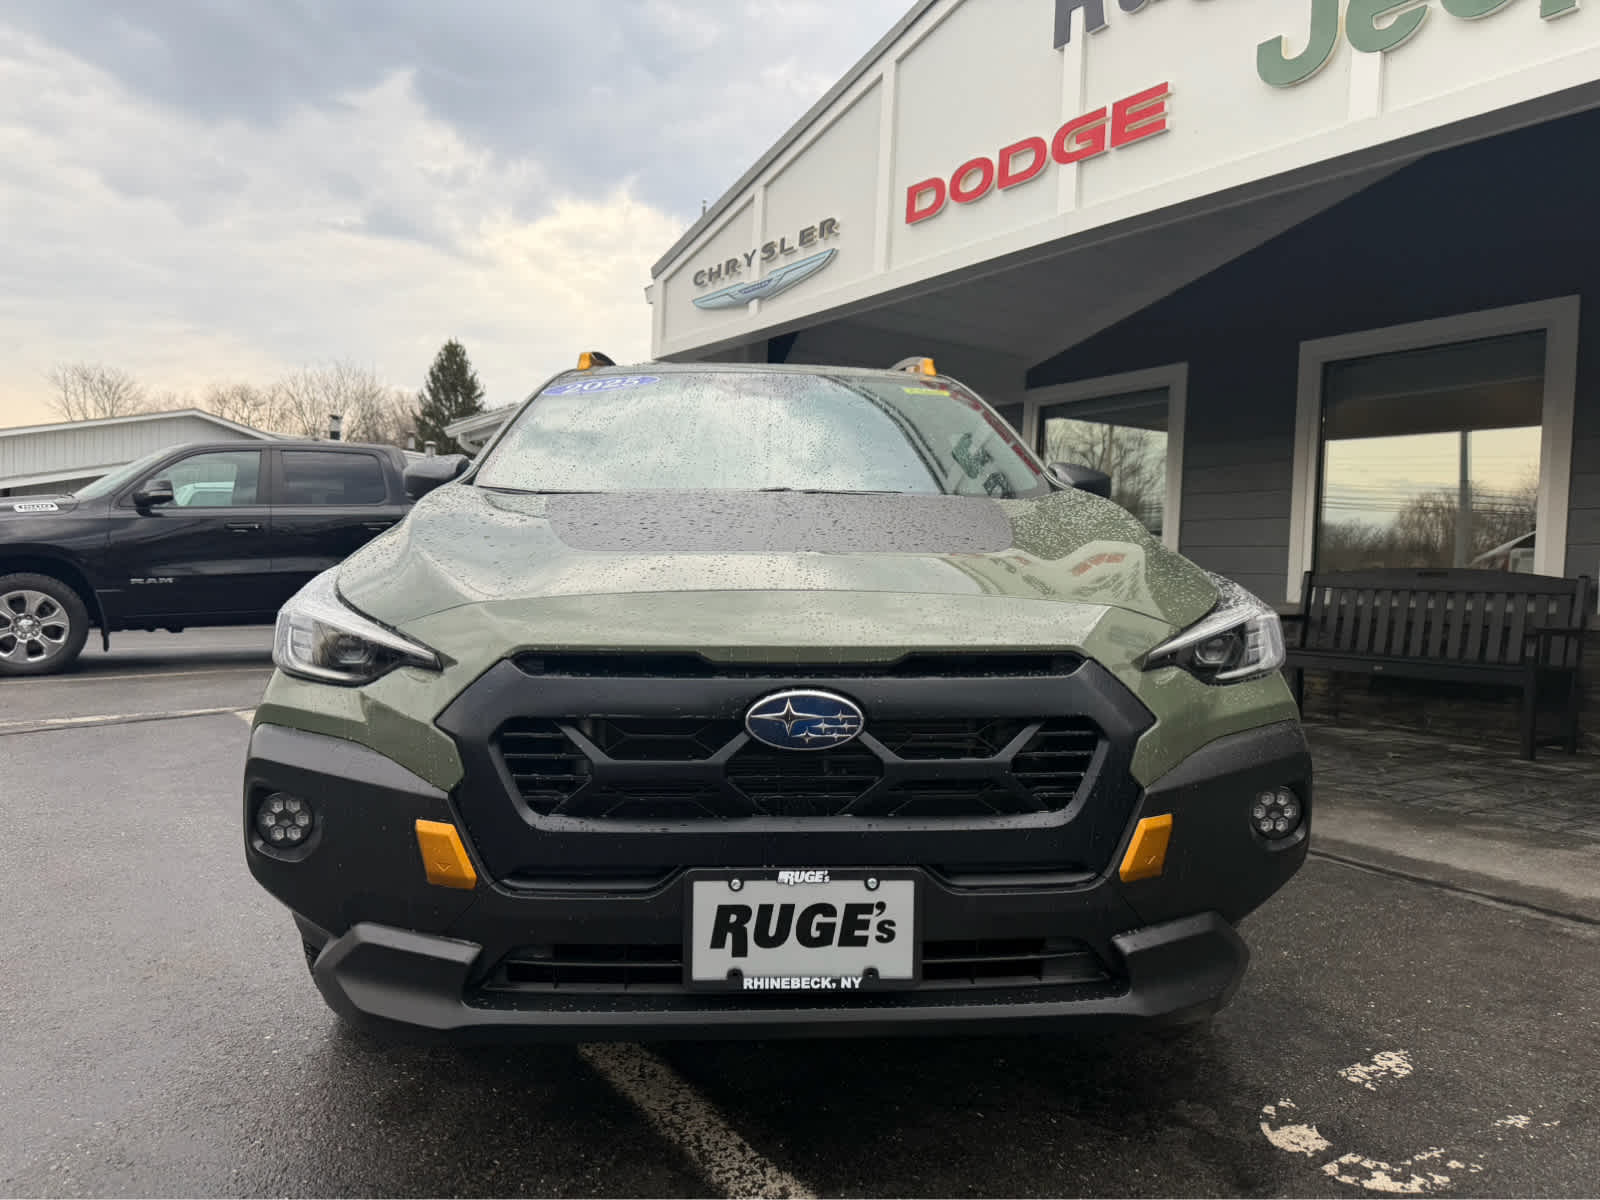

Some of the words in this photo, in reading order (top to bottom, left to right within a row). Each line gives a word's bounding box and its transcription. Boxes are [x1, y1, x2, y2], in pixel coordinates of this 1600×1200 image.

[1256, 0, 1580, 88] Je
[905, 81, 1171, 225] DODGE
[693, 217, 840, 287] CHRYSLER
[710, 901, 896, 958] RUGE's
[743, 977, 836, 990] RHINEBECK,
[841, 977, 862, 988] NY
